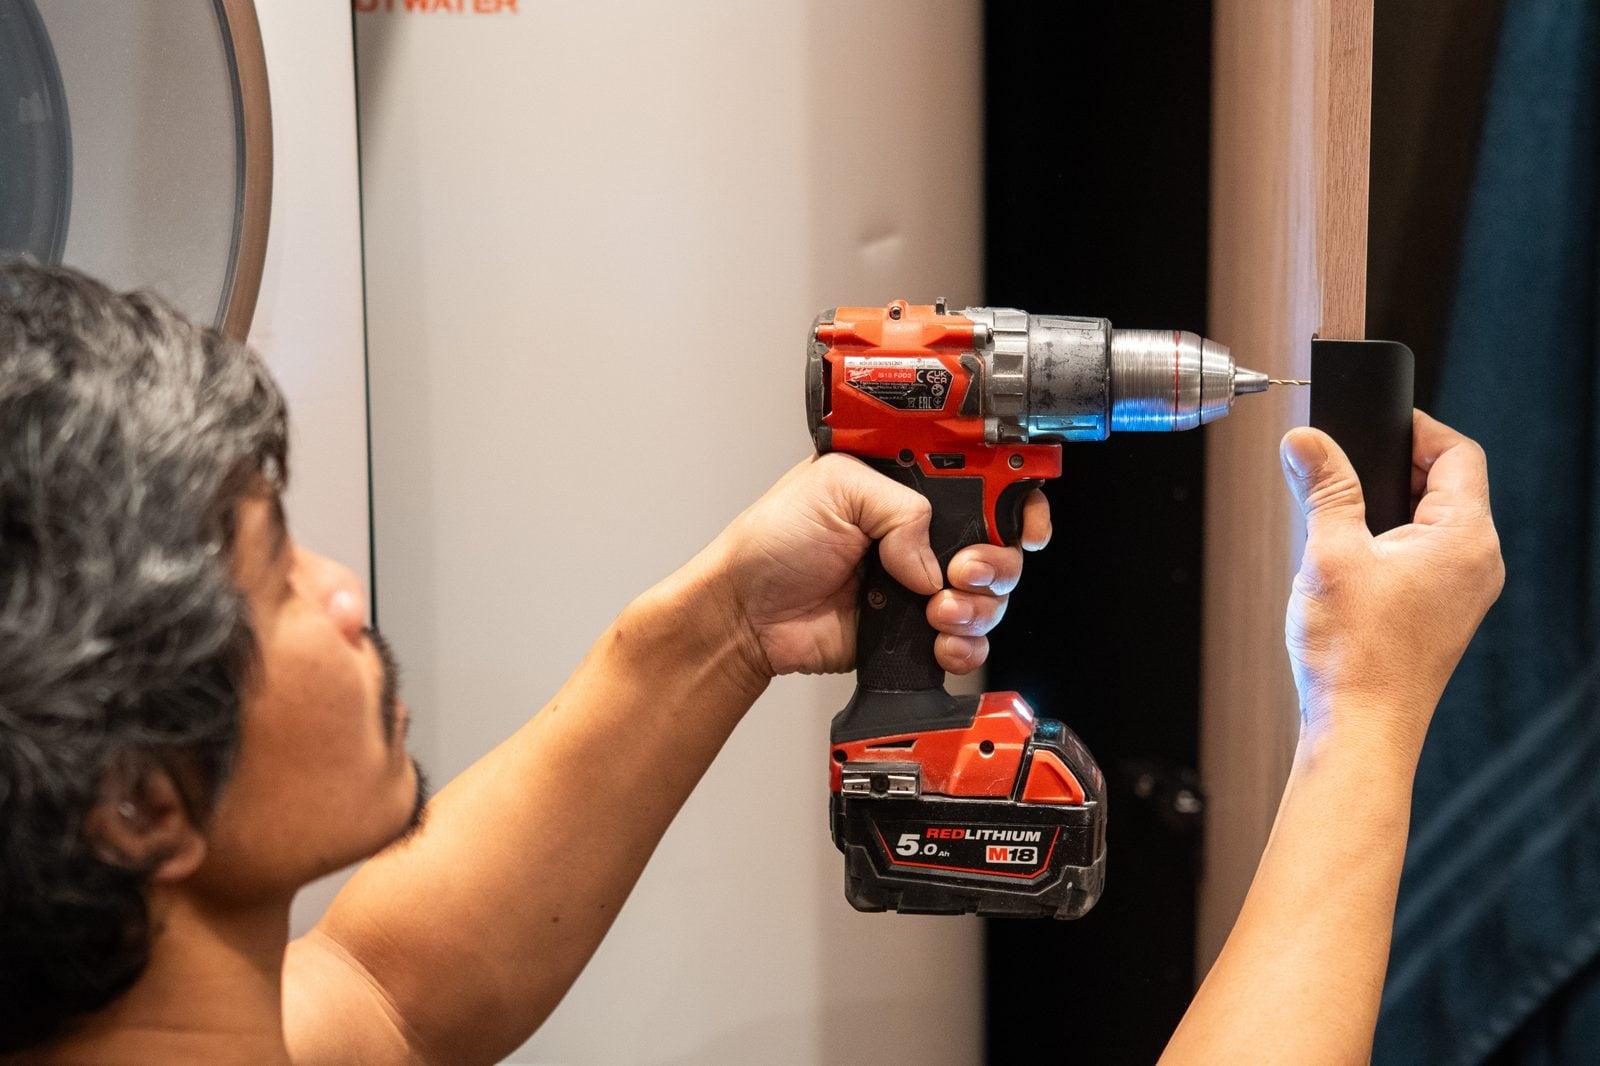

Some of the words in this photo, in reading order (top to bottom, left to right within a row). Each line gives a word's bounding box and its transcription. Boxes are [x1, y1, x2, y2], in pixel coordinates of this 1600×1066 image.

[926, 828, 1041, 842] REDLITHIUM
[896, 833, 938, 857] 5.0
[938, 850, 950, 858] Ah
[988, 847, 1035, 861] M18
